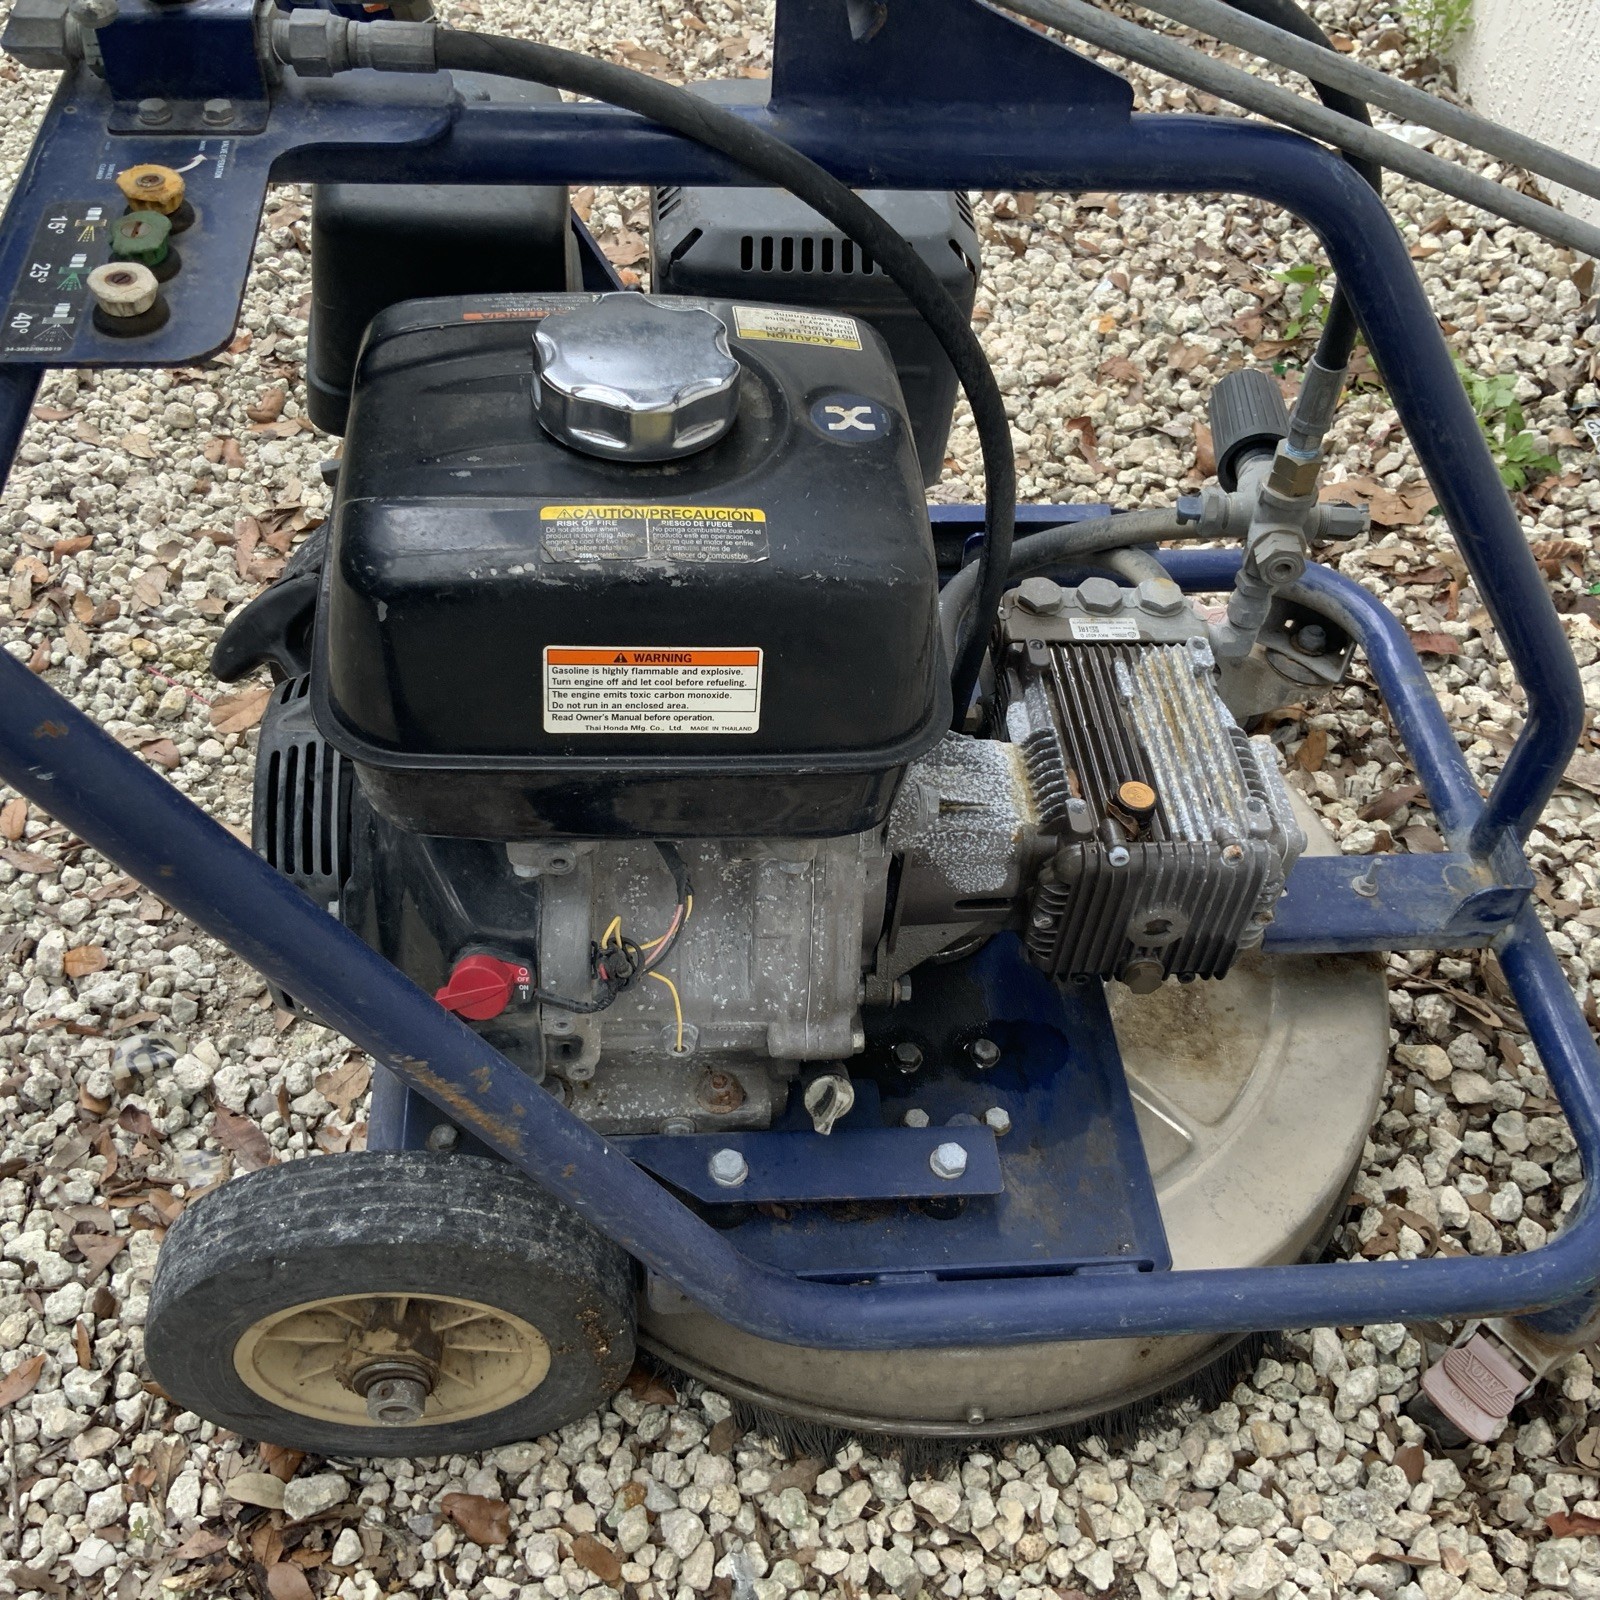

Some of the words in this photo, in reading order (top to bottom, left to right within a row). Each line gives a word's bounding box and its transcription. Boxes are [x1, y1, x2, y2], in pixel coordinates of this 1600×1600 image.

[766, 332, 820, 343] CAUTION
[633, 653, 692, 663] WARNING
[552, 667, 590, 676] Gasoline
[592, 667, 600, 676] is
[602, 666, 629, 678] highly
[631, 667, 679, 676] flammable
[682, 667, 698, 676] and
[700, 667, 744, 678] explosive.
[552, 678, 572, 686] Turn
[574, 678, 604, 688] engine
[606, 678, 620, 686] off
[622, 678, 638, 686] and
[640, 678, 652, 686] let
[654, 678, 673, 686] cool
[676, 678, 704, 687] before
[706, 678, 747, 688] refueling.
[552, 690, 568, 699] The
[571, 691, 601, 700] engine
[603, 691, 628, 699] emits
[630, 691, 652, 699] toxic
[654, 691, 685, 699] carbon
[687, 691, 732, 700] monoxide.
[552, 702, 564, 710] Do
[566, 702, 581, 710] not
[600, 702, 609, 710] in
[624, 702, 664, 710] enclosed
[552, 713, 574, 722] Read
[575, 713, 609, 722] Owner's
[611, 713, 642, 722] Manual
[644, 713, 671, 722] before
[673, 714, 715, 723] operation.
[1472, 1364, 1499, 1392] OFF
